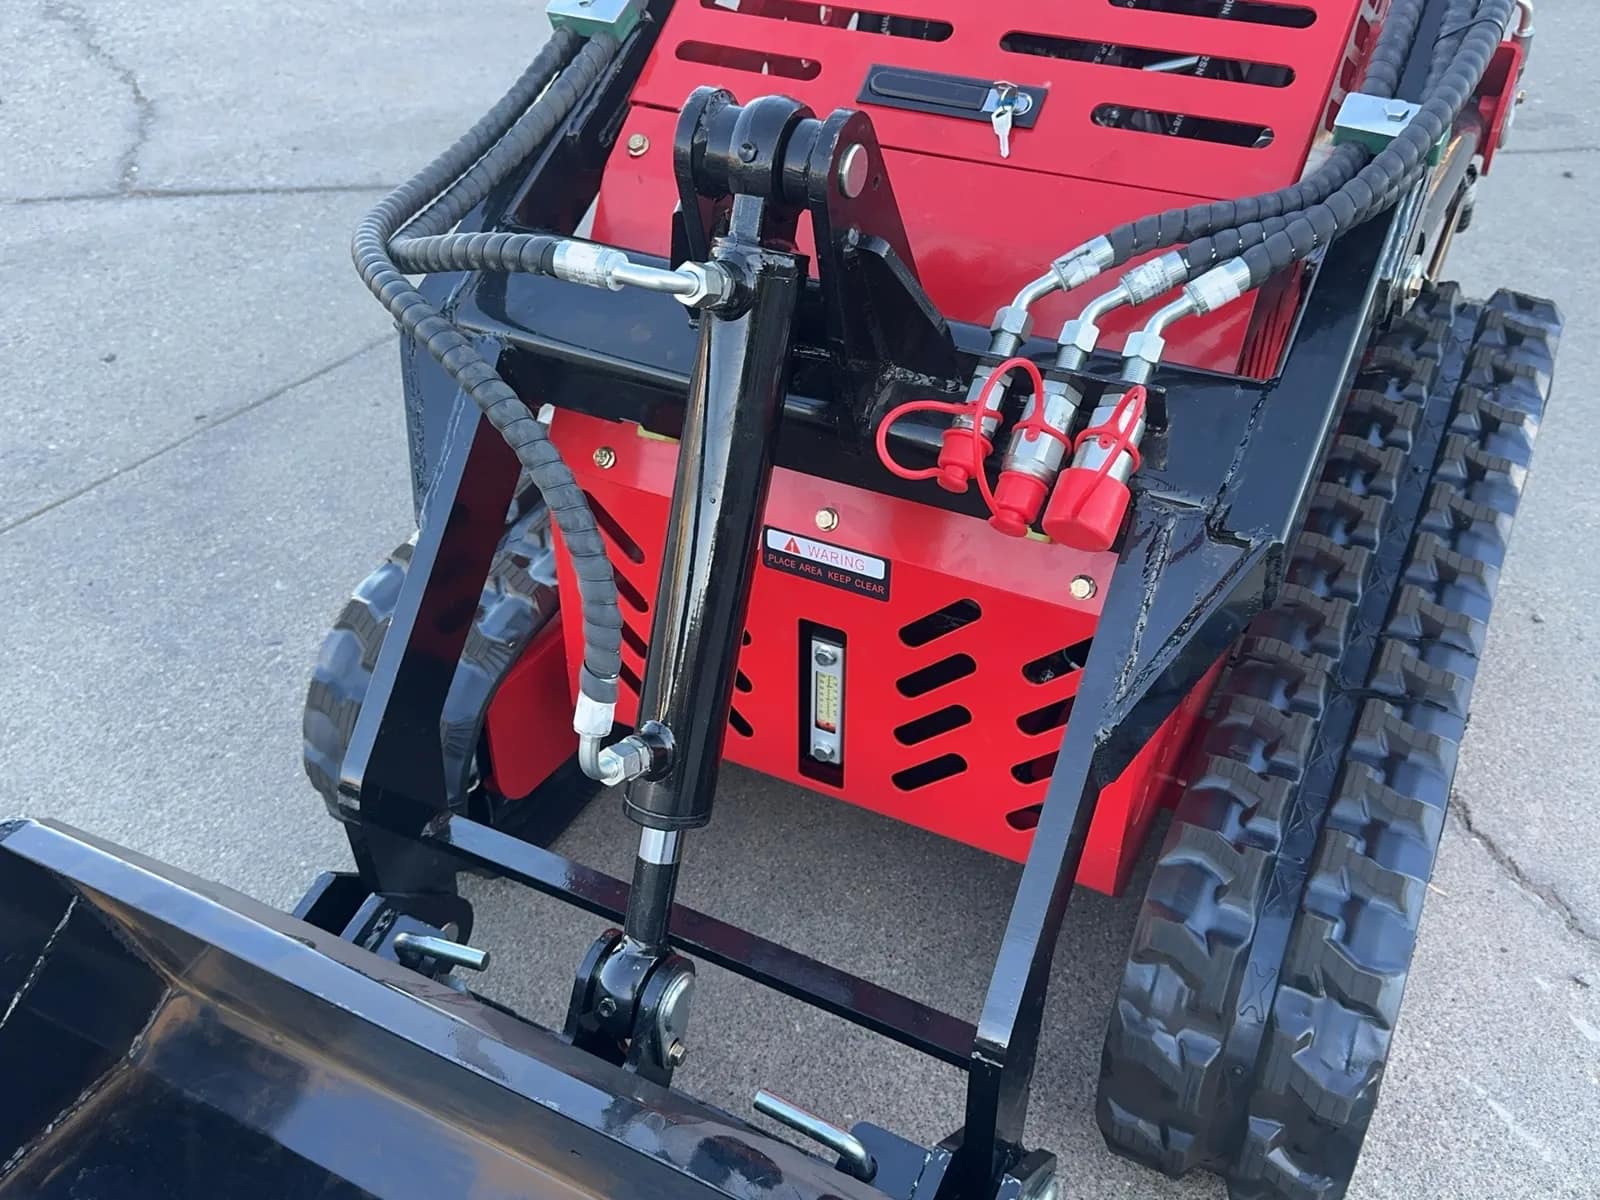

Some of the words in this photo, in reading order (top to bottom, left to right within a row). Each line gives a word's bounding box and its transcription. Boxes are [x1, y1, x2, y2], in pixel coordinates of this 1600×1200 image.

[768, 554, 796, 569] PLACE
[799, 563, 823, 577] AREA
[828, 571, 852, 584] KEEP
[854, 578, 885, 594] CLEAR
[808, 544, 865, 571] WARING
